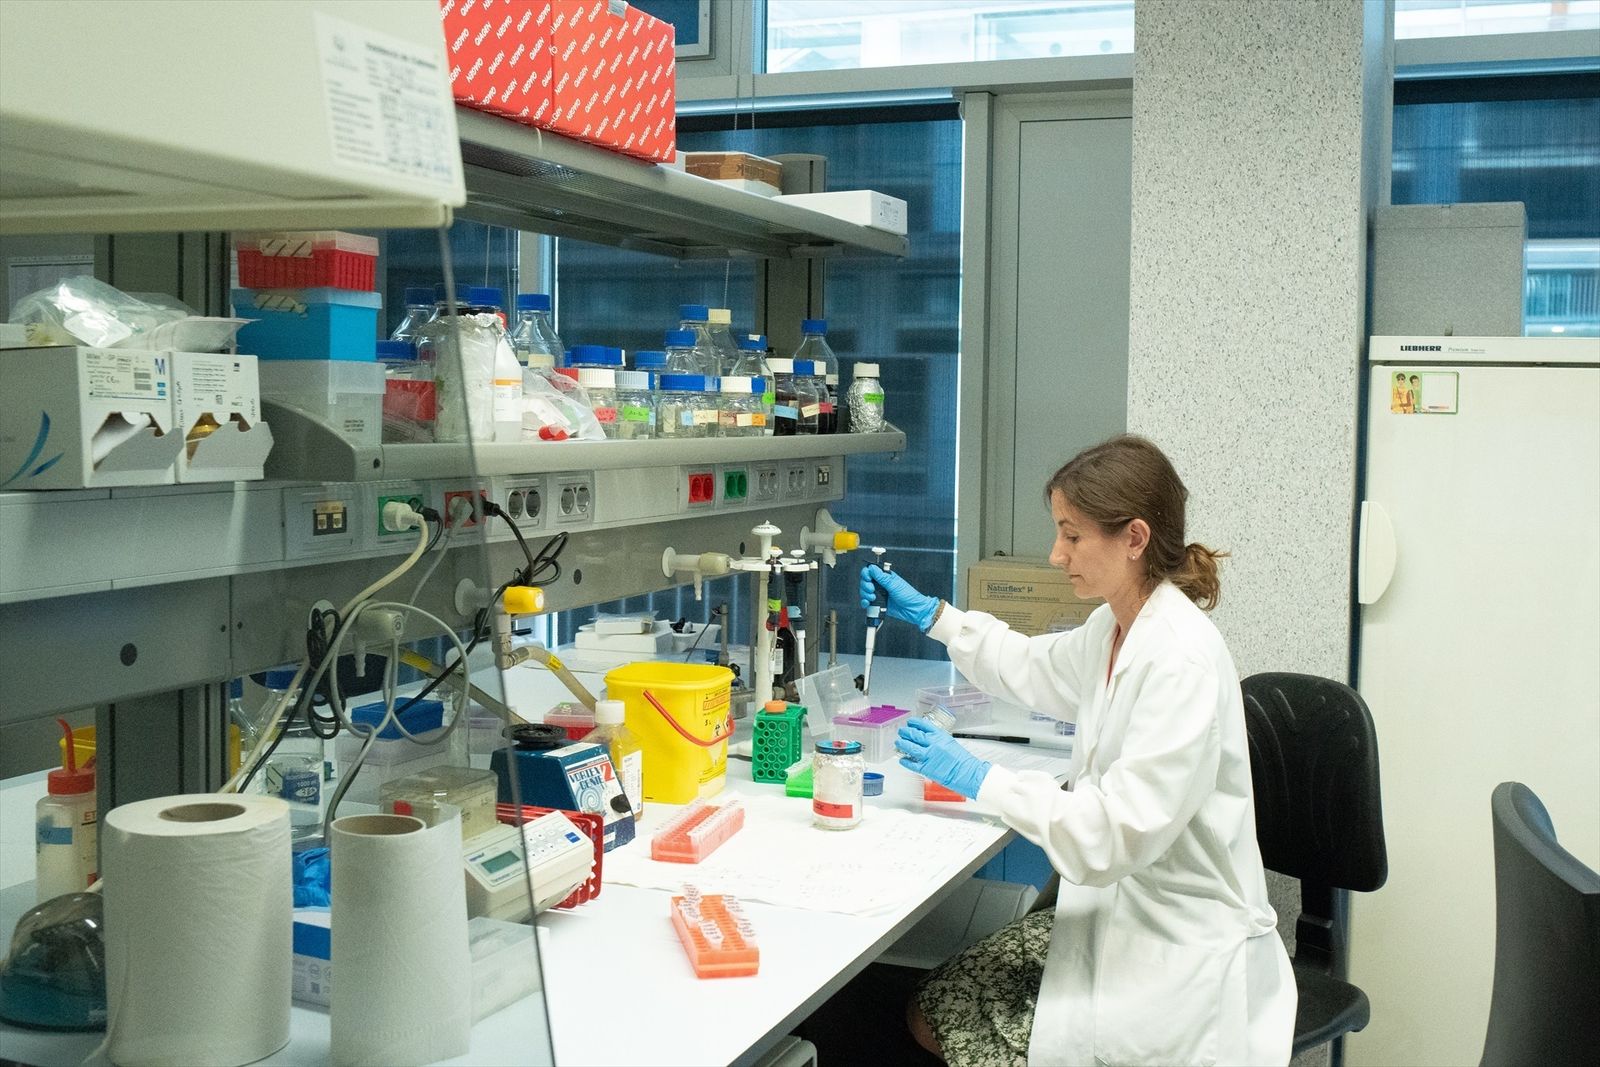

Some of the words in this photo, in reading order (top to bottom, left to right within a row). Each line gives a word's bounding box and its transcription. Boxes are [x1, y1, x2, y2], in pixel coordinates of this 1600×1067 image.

[517, 9, 532, 32] QIAGEN
[536, 3, 551, 26] QIAGEN
[569, 6, 585, 28] QIAGEN
[474, 22, 492, 46] QIAGEN
[496, 15, 512, 40] QIAGEN
[599, 26, 613, 48] QIAGEN
[616, 21, 629, 41] QIAGEN
[452, 28, 469, 54] QIAGEN
[529, 36, 544, 60] QIAGEN
[562, 39, 577, 62] QIAGEN
[580, 33, 596, 55] QIAGEN
[642, 40, 654, 60] QIAGEN
[656, 34, 668, 54] QIAGEN
[488, 50, 505, 75] QIAGEN
[509, 43, 525, 67] QIAGEN
[610, 52, 623, 74] QIAGEN
[626, 46, 639, 66] QIAGEN
[466, 57, 483, 82] QIAGEN
[574, 65, 588, 88] QIAGEN
[592, 58, 606, 80] QIAGEN
[652, 64, 663, 84] QIAGEN
[501, 78, 517, 103] QIAGEN
[522, 71, 537, 95] QIAGEN
[554, 72, 570, 95] QIAGEN
[620, 77, 633, 98] QIAGEN
[636, 70, 648, 91] QIAGEN
[584, 91, 599, 113] QIAGEN
[602, 84, 616, 105] QIAGEN
[645, 94, 657, 114] QIAGEN
[660, 88, 671, 108] QIAGEN
[566, 98, 580, 121] QIAGEN
[612, 108, 626, 130] QIAGEN
[630, 102, 642, 122] QIAGEN
[596, 116, 609, 138] QIAGEN
[639, 126, 650, 146] QIAGEN
[654, 117, 666, 138] QIAGEN
[569, 766, 601, 783] VORTEX
[600, 762, 615, 782] 2
